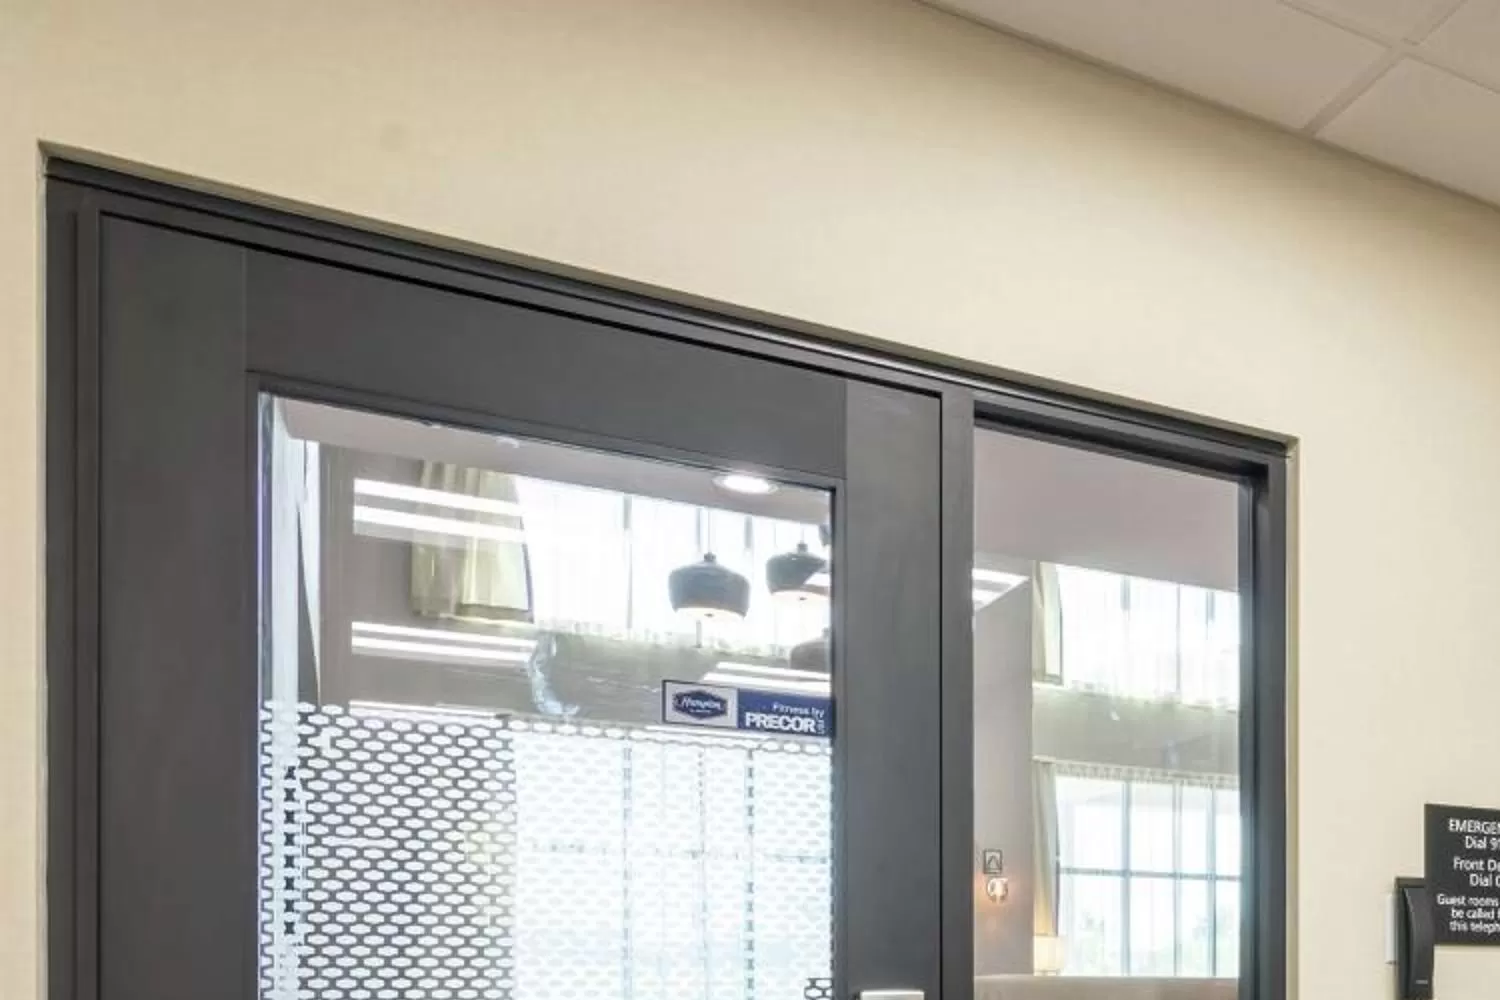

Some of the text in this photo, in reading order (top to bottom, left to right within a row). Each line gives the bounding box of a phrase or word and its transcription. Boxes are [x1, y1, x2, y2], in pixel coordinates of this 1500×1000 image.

[772, 702, 825, 719] Fitness by
[745, 712, 817, 734] PRECOR
[1465, 835, 1487, 849] Dial
[1453, 856, 1485, 871] Front
[1469, 873, 1492, 887] Dial
[1436, 893, 1466, 906] Guest
[1468, 896, 1499, 908] rooms
[1451, 908, 1465, 919] be
[1466, 908, 1495, 920] called
[1449, 920, 1468, 932] this
